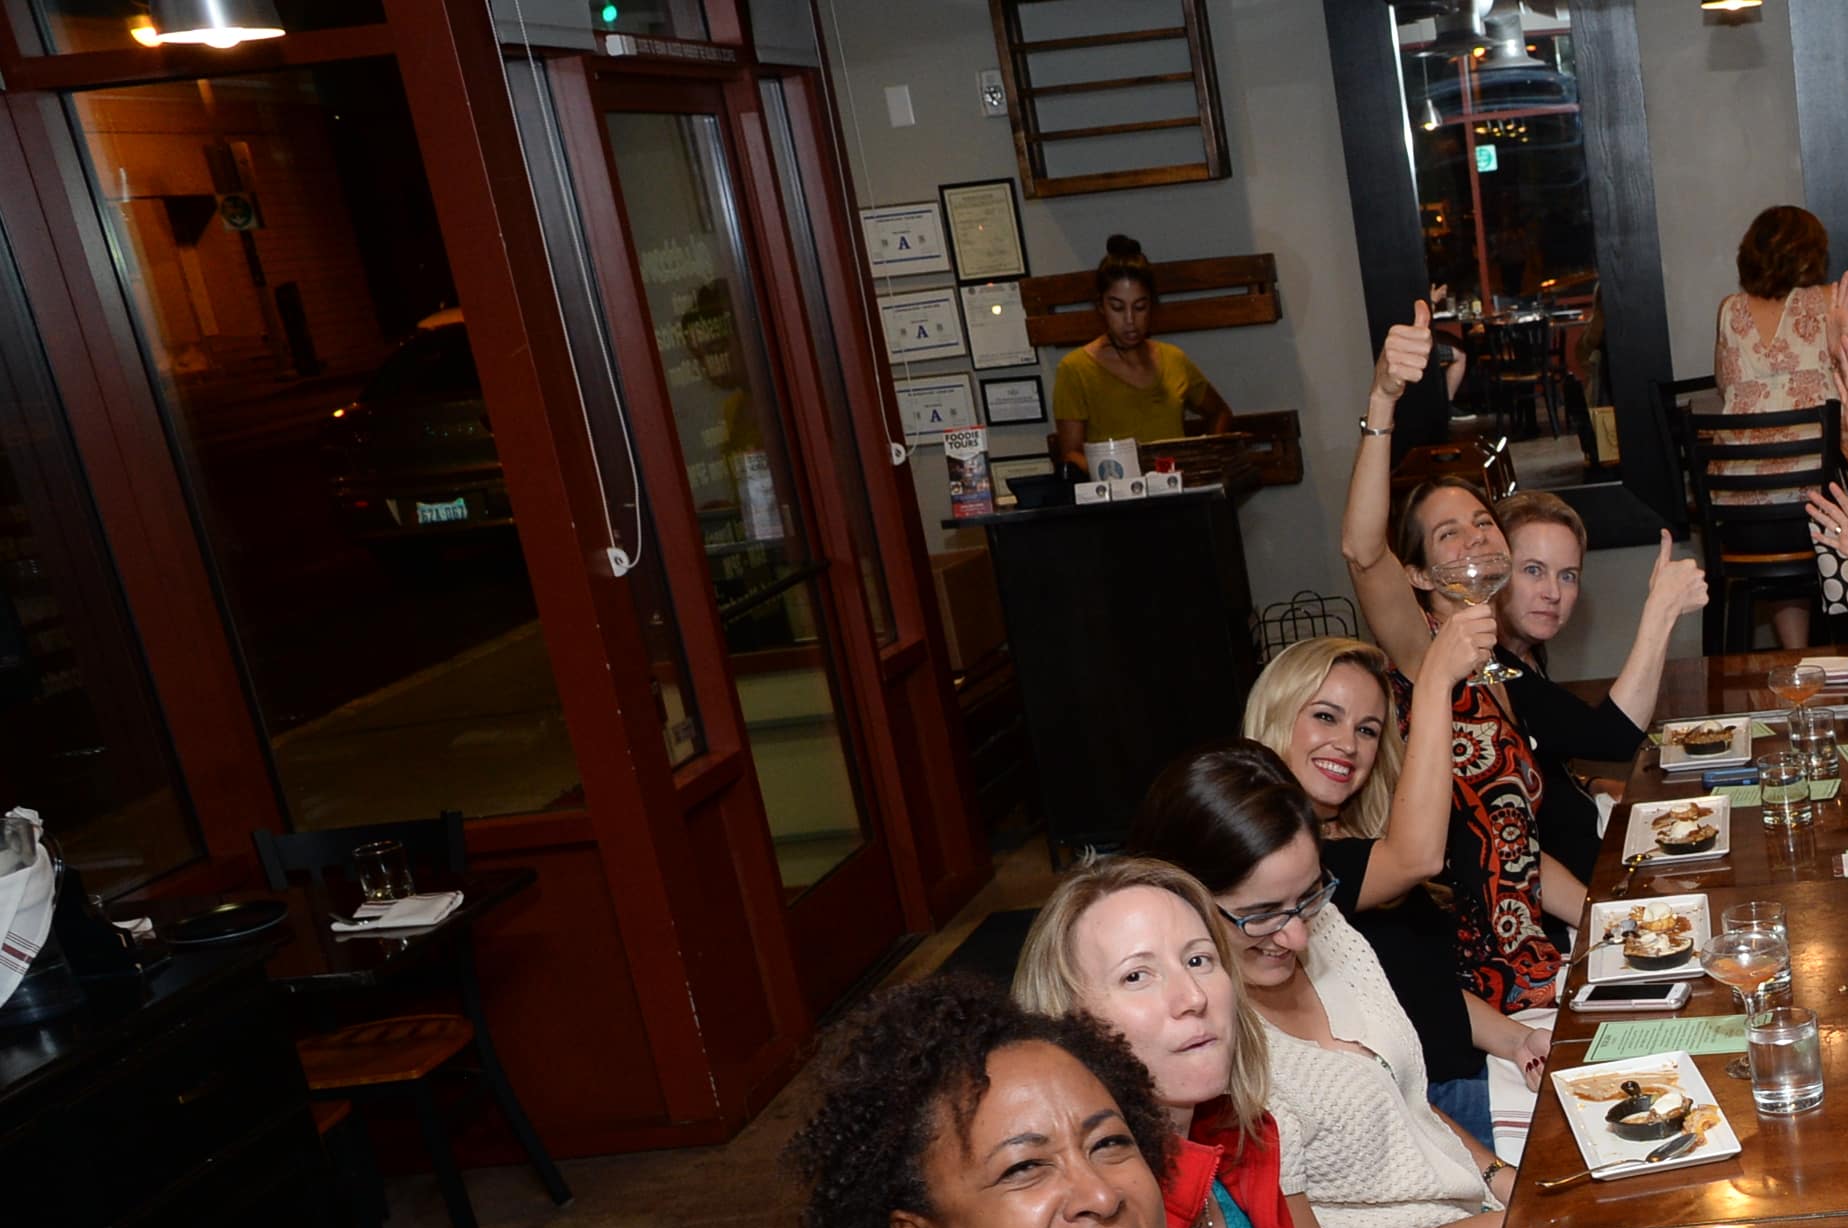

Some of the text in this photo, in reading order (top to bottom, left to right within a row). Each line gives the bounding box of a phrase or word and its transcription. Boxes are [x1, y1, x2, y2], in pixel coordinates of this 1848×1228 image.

[897, 236, 911, 250] A
[916, 325, 929, 339] A
[930, 409, 943, 423] A
[945, 431, 980, 443] FOODIE
[948, 439, 980, 450] TOURS
